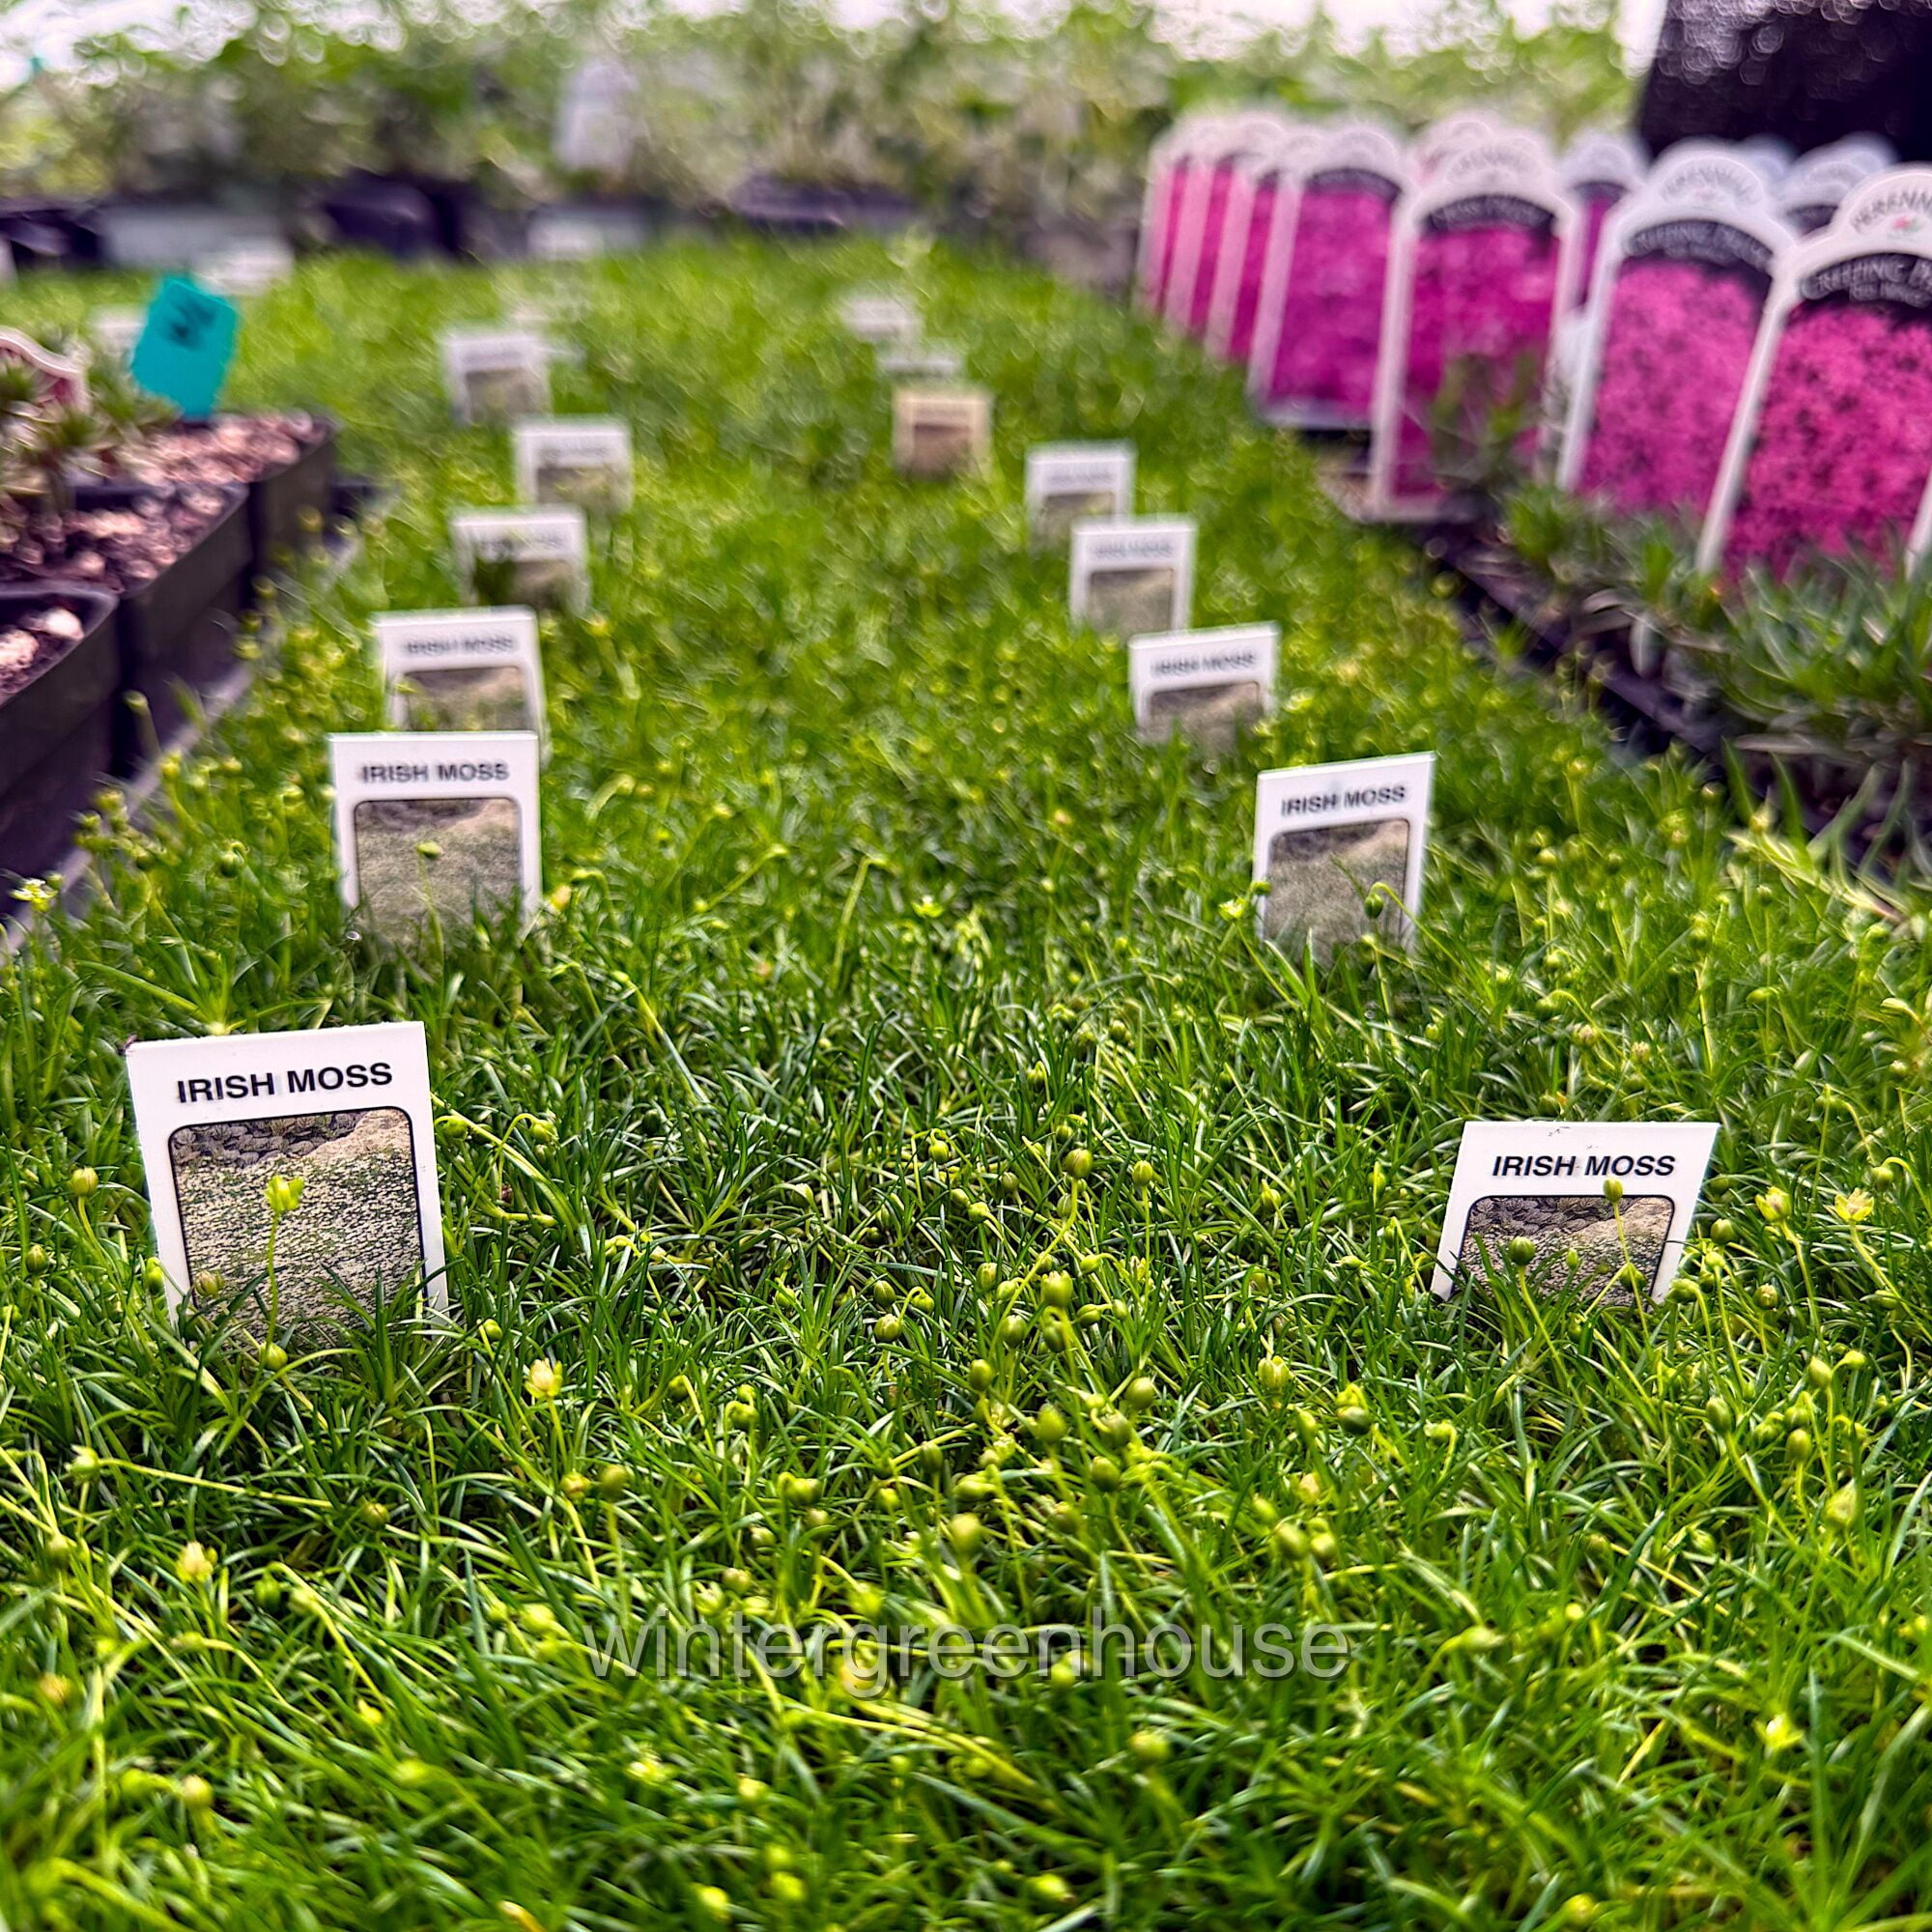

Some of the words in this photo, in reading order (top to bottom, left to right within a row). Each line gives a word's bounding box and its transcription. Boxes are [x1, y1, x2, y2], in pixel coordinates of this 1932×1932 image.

[361, 764, 429, 783] IRISH
[437, 760, 510, 781] MOSS
[1281, 793, 1337, 816] IRISH
[1344, 785, 1406, 809] MOSS
[177, 1072, 275, 1103] IRISH
[287, 1063, 393, 1094] MOSS
[1492, 1155, 1577, 1177] IRISH
[1584, 1155, 1676, 1177] MOSS
